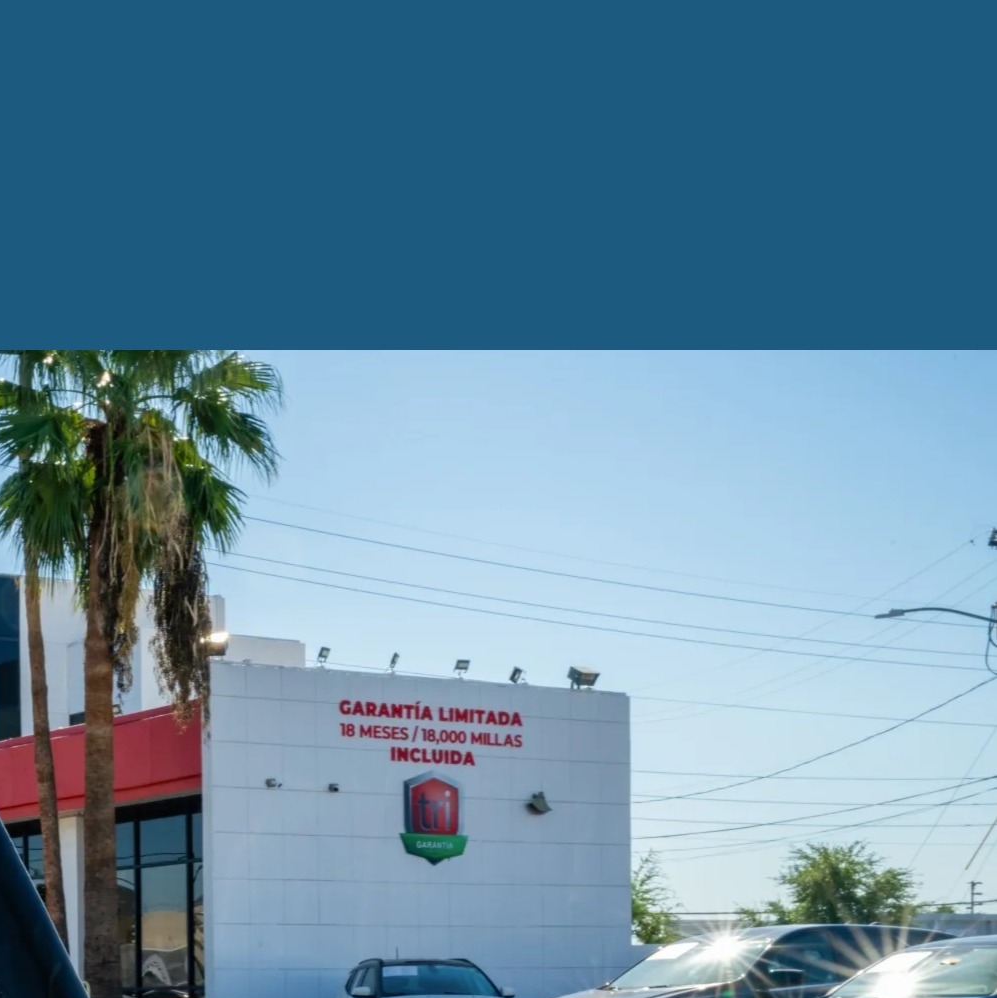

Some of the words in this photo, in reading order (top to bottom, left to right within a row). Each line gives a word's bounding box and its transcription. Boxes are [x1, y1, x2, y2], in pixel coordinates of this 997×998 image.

[339, 700, 433, 721] GARANTÍA
[438, 707, 523, 727] LIMITADA
[340, 723, 355, 737] 18
[359, 724, 409, 741] MESES
[411, 725, 419, 743] /
[421, 728, 467, 745] 18,000
[470, 732, 523, 748] MILLAS
[390, 746, 475, 766] INCLUIDA
[417, 790, 451, 831] tri
